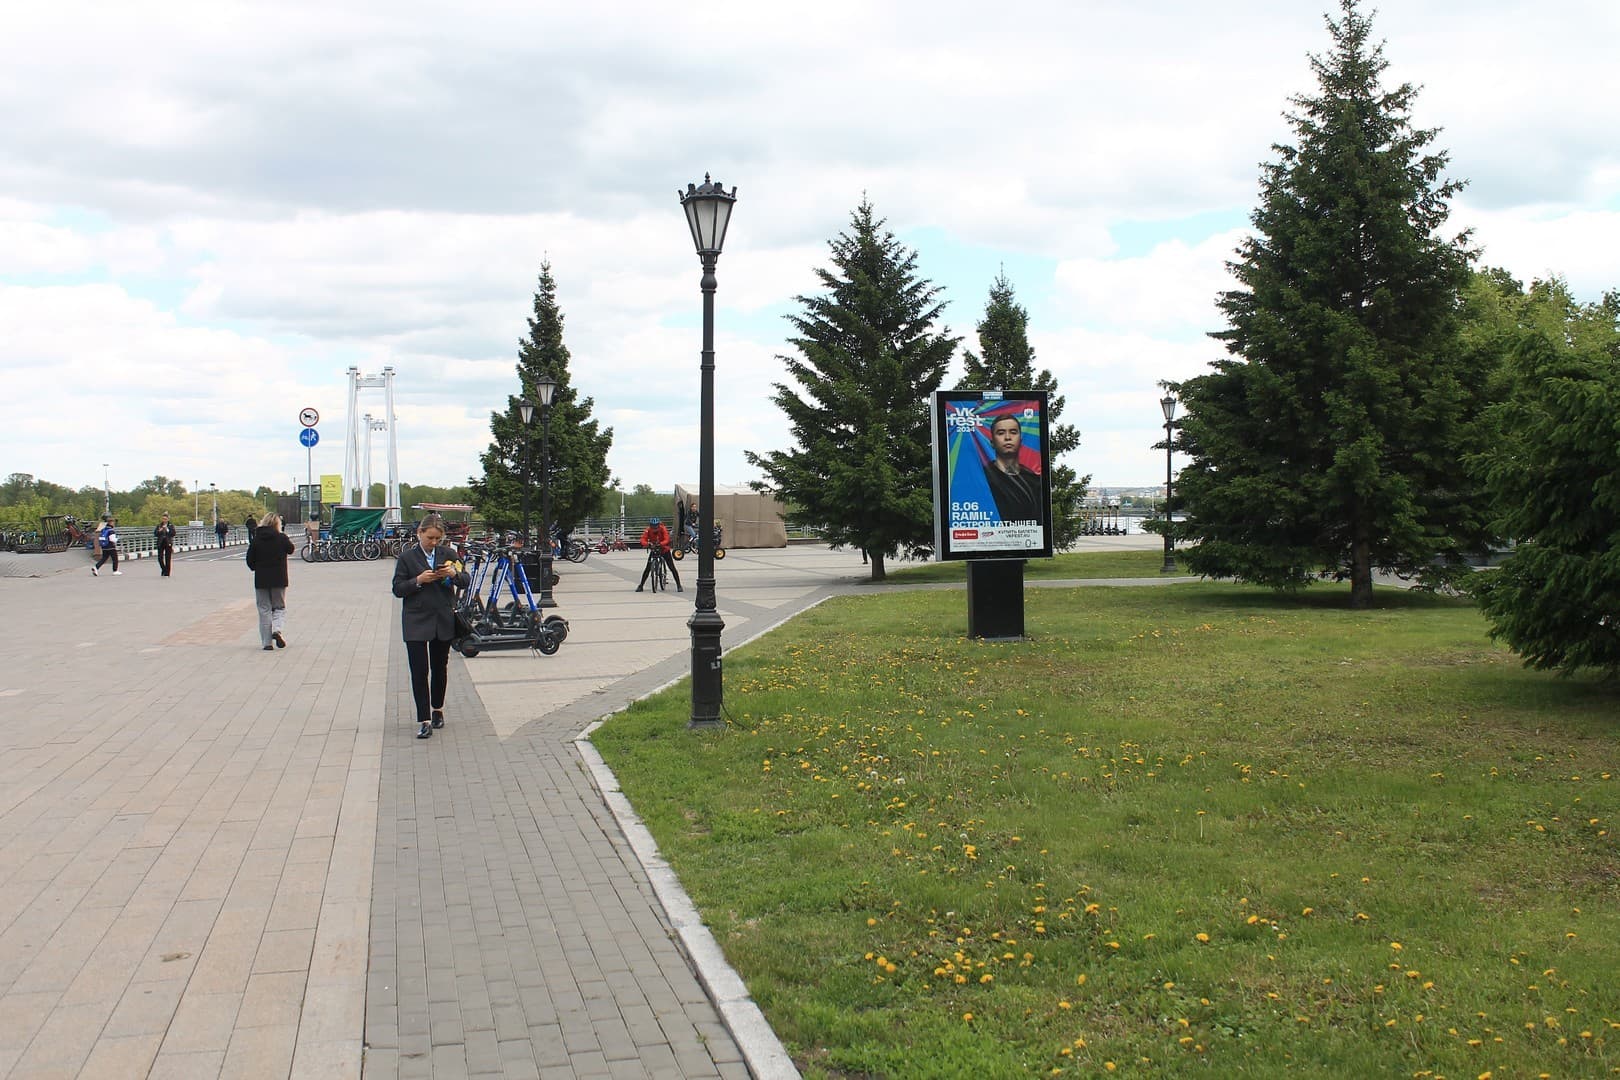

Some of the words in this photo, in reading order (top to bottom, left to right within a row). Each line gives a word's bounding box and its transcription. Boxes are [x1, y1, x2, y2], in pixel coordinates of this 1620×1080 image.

[955, 407, 976, 417] VK
[947, 413, 986, 427] fest
[952, 502, 979, 511] 8.06
